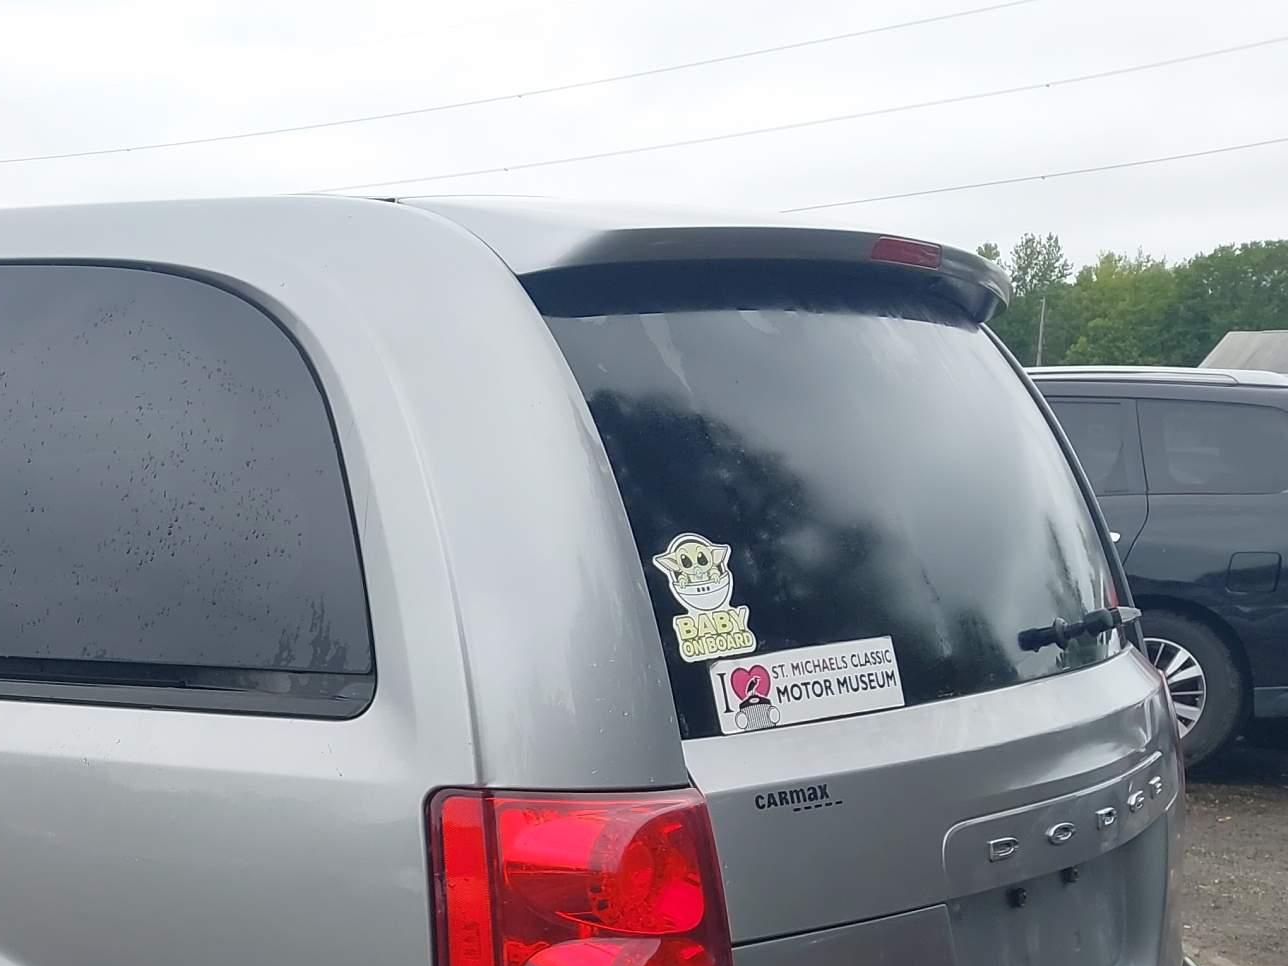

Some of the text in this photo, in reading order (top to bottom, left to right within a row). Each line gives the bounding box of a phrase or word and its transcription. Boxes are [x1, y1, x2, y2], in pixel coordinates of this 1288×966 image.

[675, 608, 747, 640] BABY
[682, 631, 753, 657] ON BOARD
[771, 650, 892, 679] ST. MICHAELS CLASSIC
[717, 673, 734, 714] I
[776, 670, 897, 703] MOTOR MUSEUM
[987, 776, 1163, 863] DODGE
